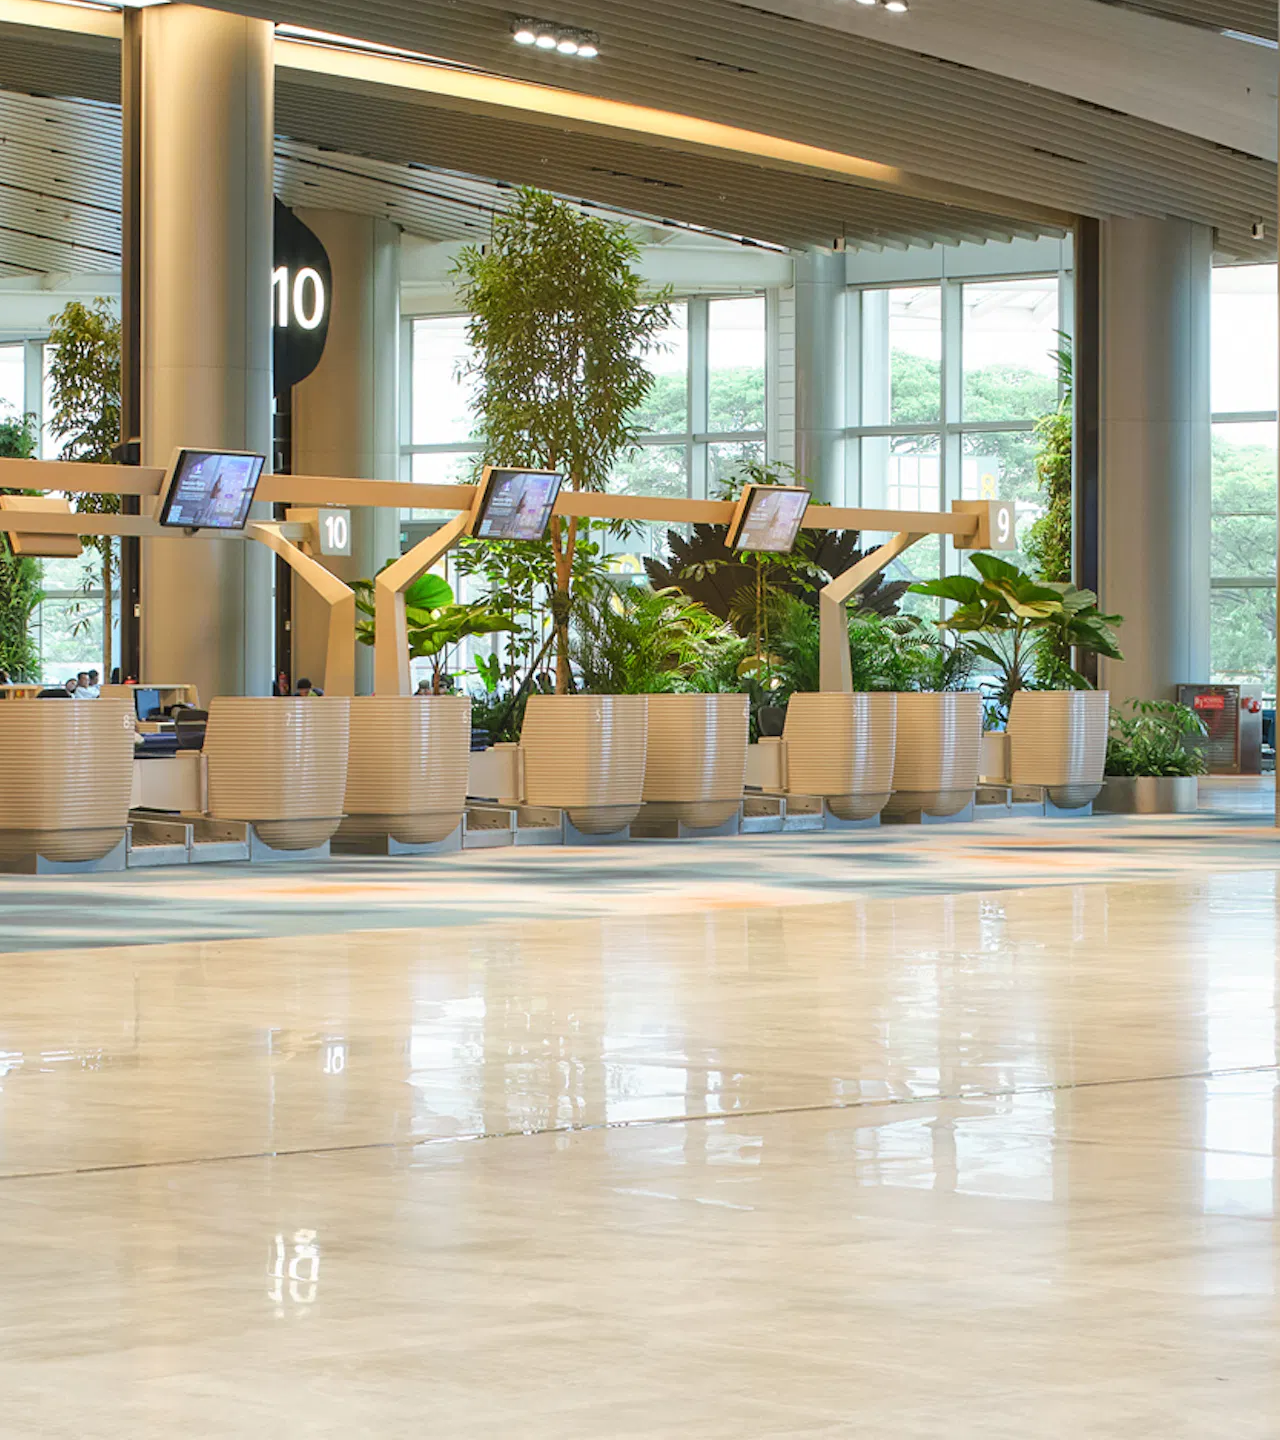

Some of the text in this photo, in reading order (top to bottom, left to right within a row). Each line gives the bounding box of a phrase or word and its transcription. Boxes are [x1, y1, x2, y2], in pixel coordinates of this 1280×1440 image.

[273, 265, 325, 331] 10
[324, 516, 348, 549] 10
[997, 507, 1010, 544] 9
[122, 713, 130, 730] 8
